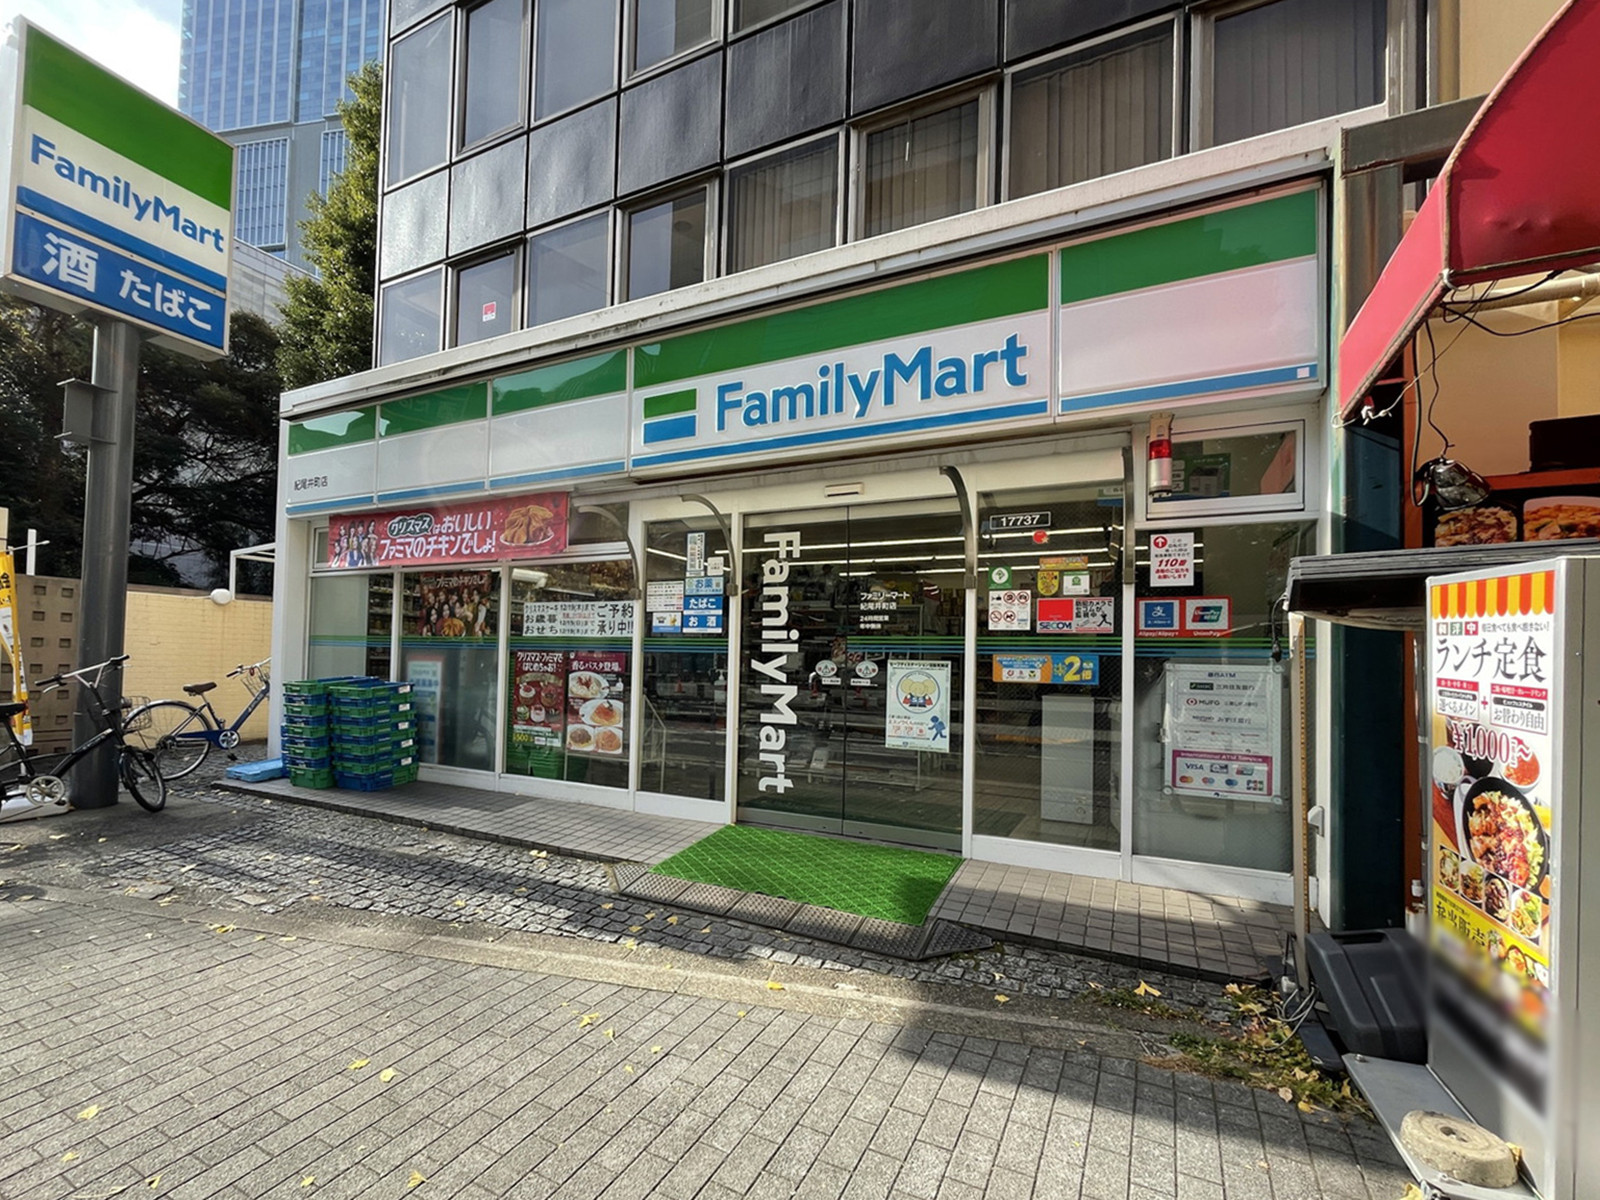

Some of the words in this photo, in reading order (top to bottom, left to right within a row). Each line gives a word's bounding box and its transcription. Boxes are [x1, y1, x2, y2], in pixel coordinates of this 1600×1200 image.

[31, 133, 224, 254] FamilyMart
[42, 231, 99, 293] 酒
[119, 269, 212, 331] たばこ
[716, 332, 1028, 432] FamilyMart
[1000, 515, 1040, 526] 17737
[689, 598, 716, 608] たばこ
[860, 591, 910, 600] ファミリーマート
[597, 603, 634, 619] ご予約
[524, 625, 559, 635] おせち
[1039, 621, 1072, 630] SECOM
[751, 531, 800, 794] FamilyMart
[1436, 635, 1547, 683] ランチ定食
